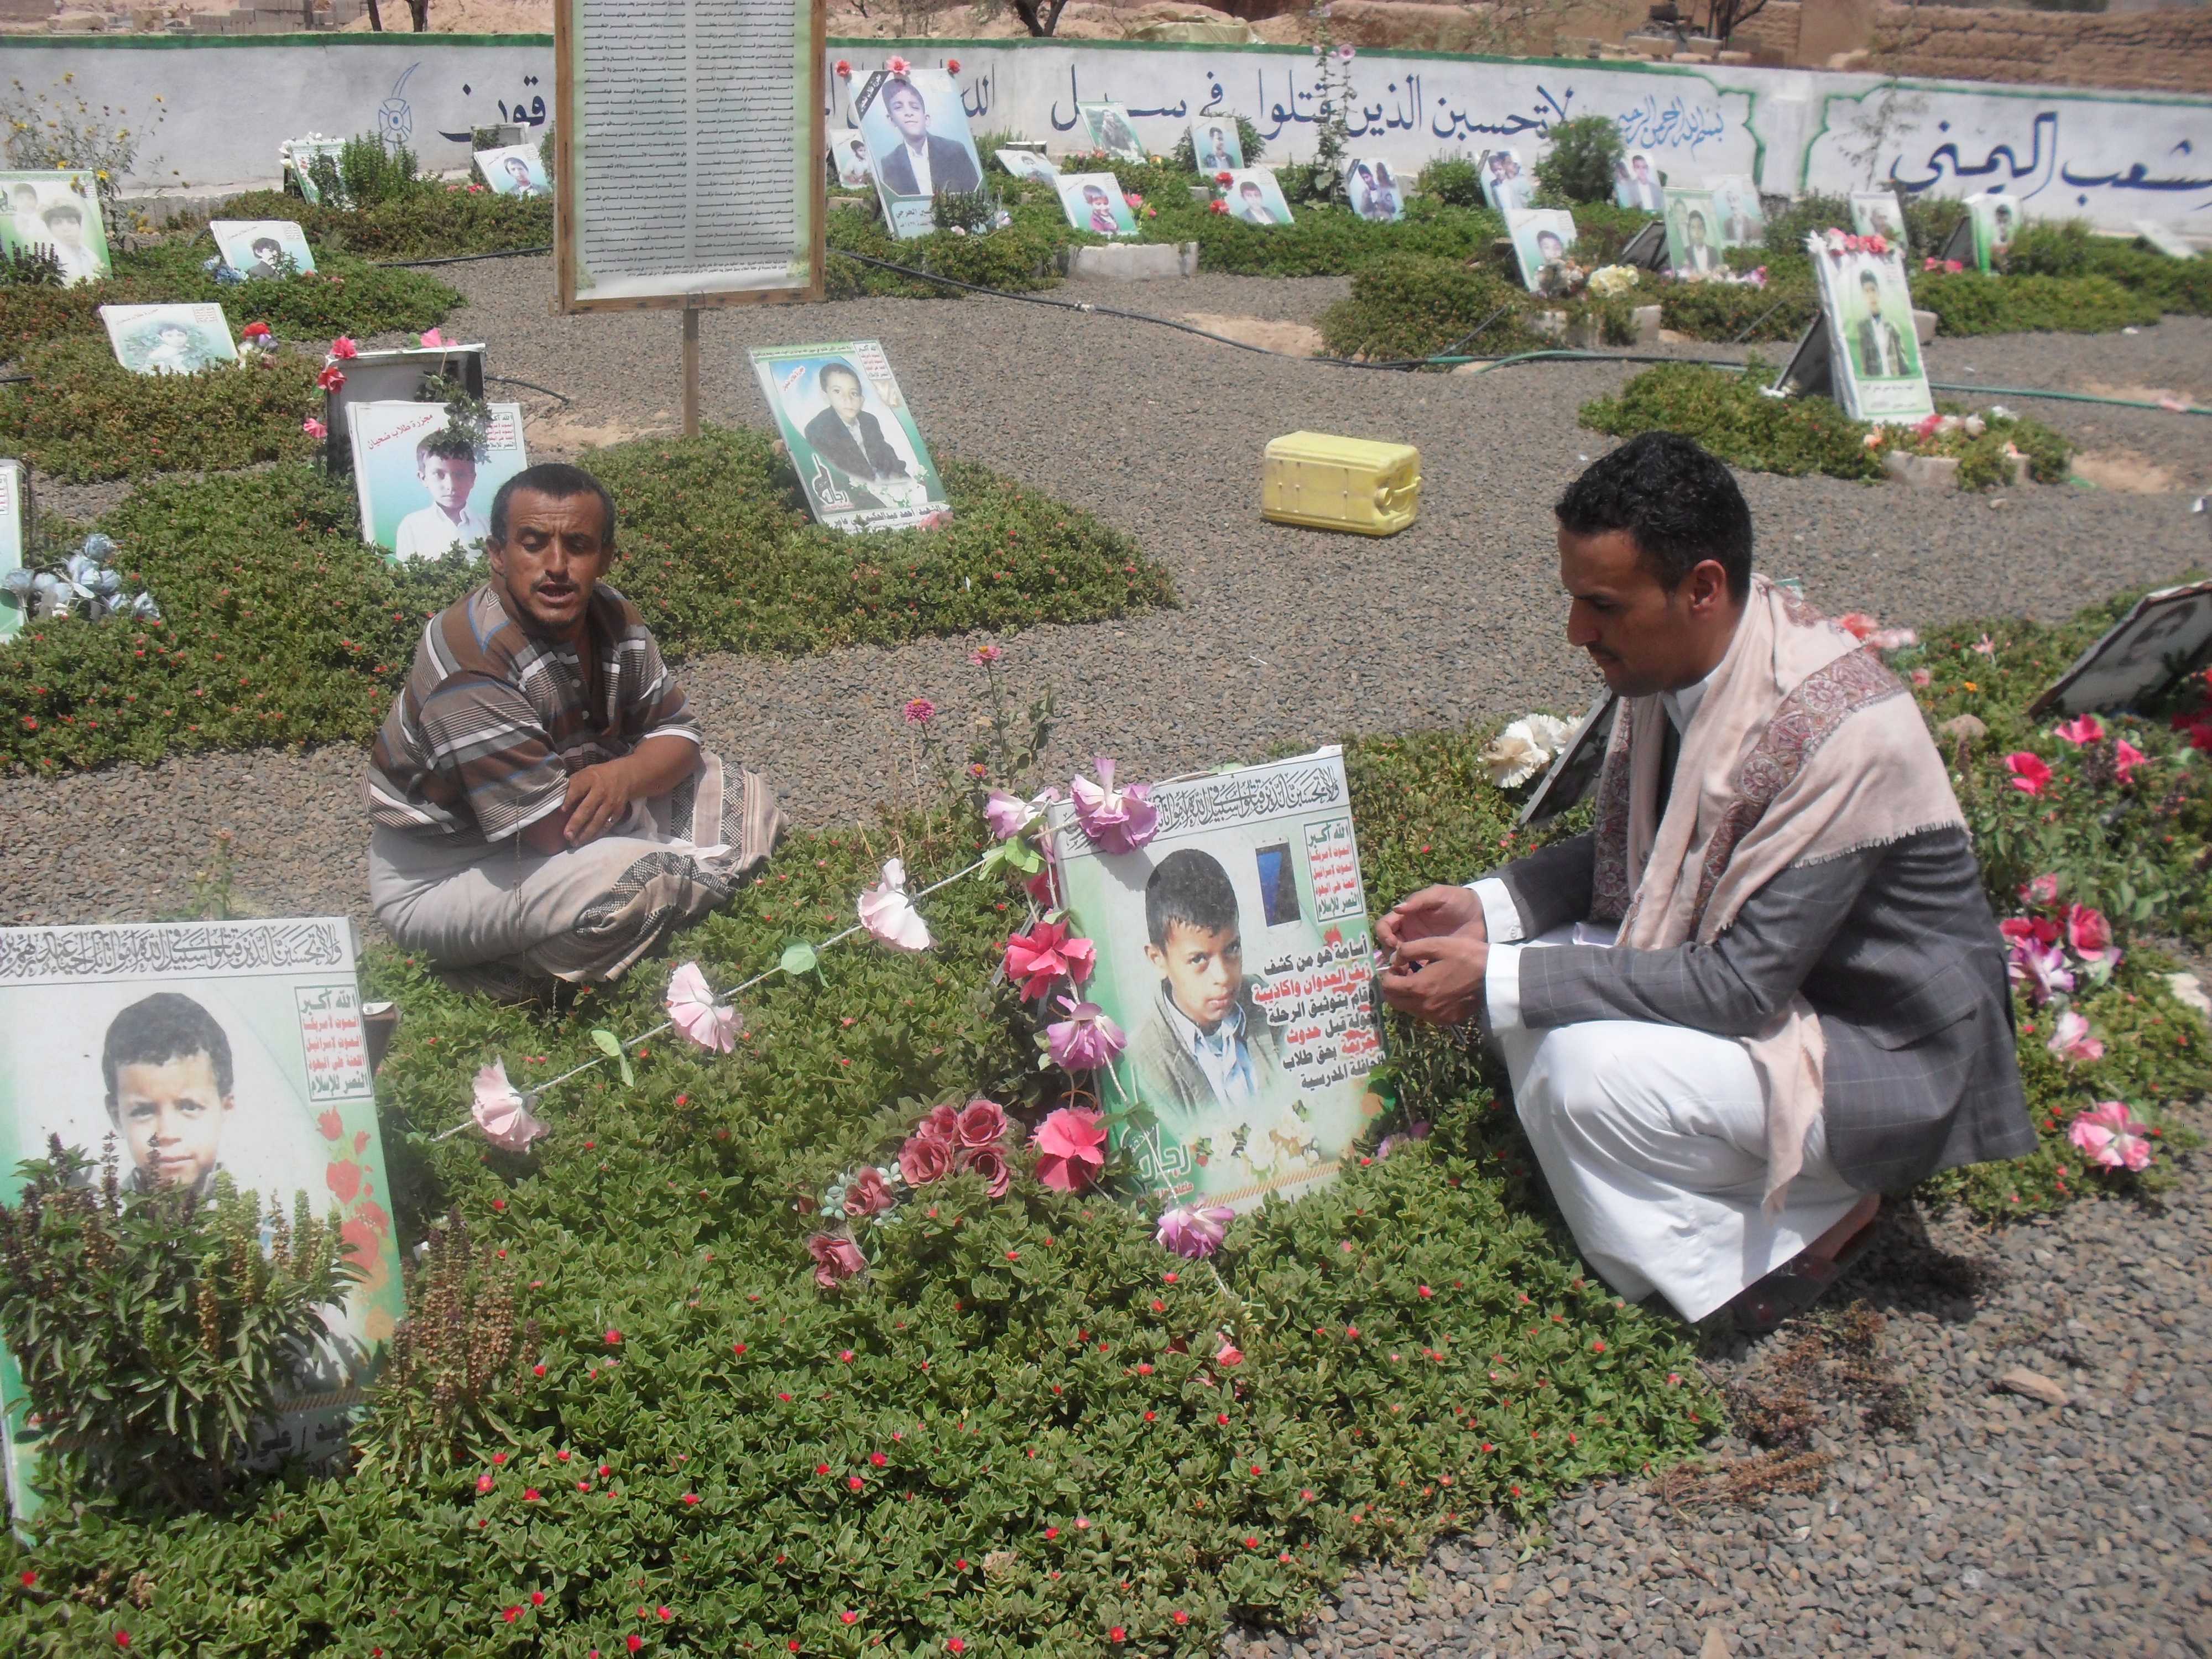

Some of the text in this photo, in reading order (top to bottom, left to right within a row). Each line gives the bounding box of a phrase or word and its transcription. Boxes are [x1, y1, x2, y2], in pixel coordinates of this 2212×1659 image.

[367, 413, 434, 450] مجزرة طلاب ضحيان
[1308, 822, 1349, 849] الله أكبر
[1333, 843, 1352, 858] الموت
[1335, 861, 1355, 875] الموت
[1342, 891, 1361, 914] النصر
[1264, 934, 1369, 976] أسامة هو من كشف
[1303, 968, 1347, 994] العدوان
[1348, 963, 1373, 982] زيف
[300, 988, 357, 1016] الله أكبر
[1267, 984, 1375, 1023] وقام بتوثيق الرحلة
[335, 1015, 359, 1031] الموت
[1325, 1016, 1347, 1038] قبل
[337, 1035, 363, 1051] الموت
[1286, 1025, 1322, 1045] حدوث
[1282, 1048, 1314, 1071] طلاب
[1316, 1045, 1337, 1065] بحق
[343, 1071, 369, 1095] النصر
[1300, 1063, 1349, 1091] المدرسية
